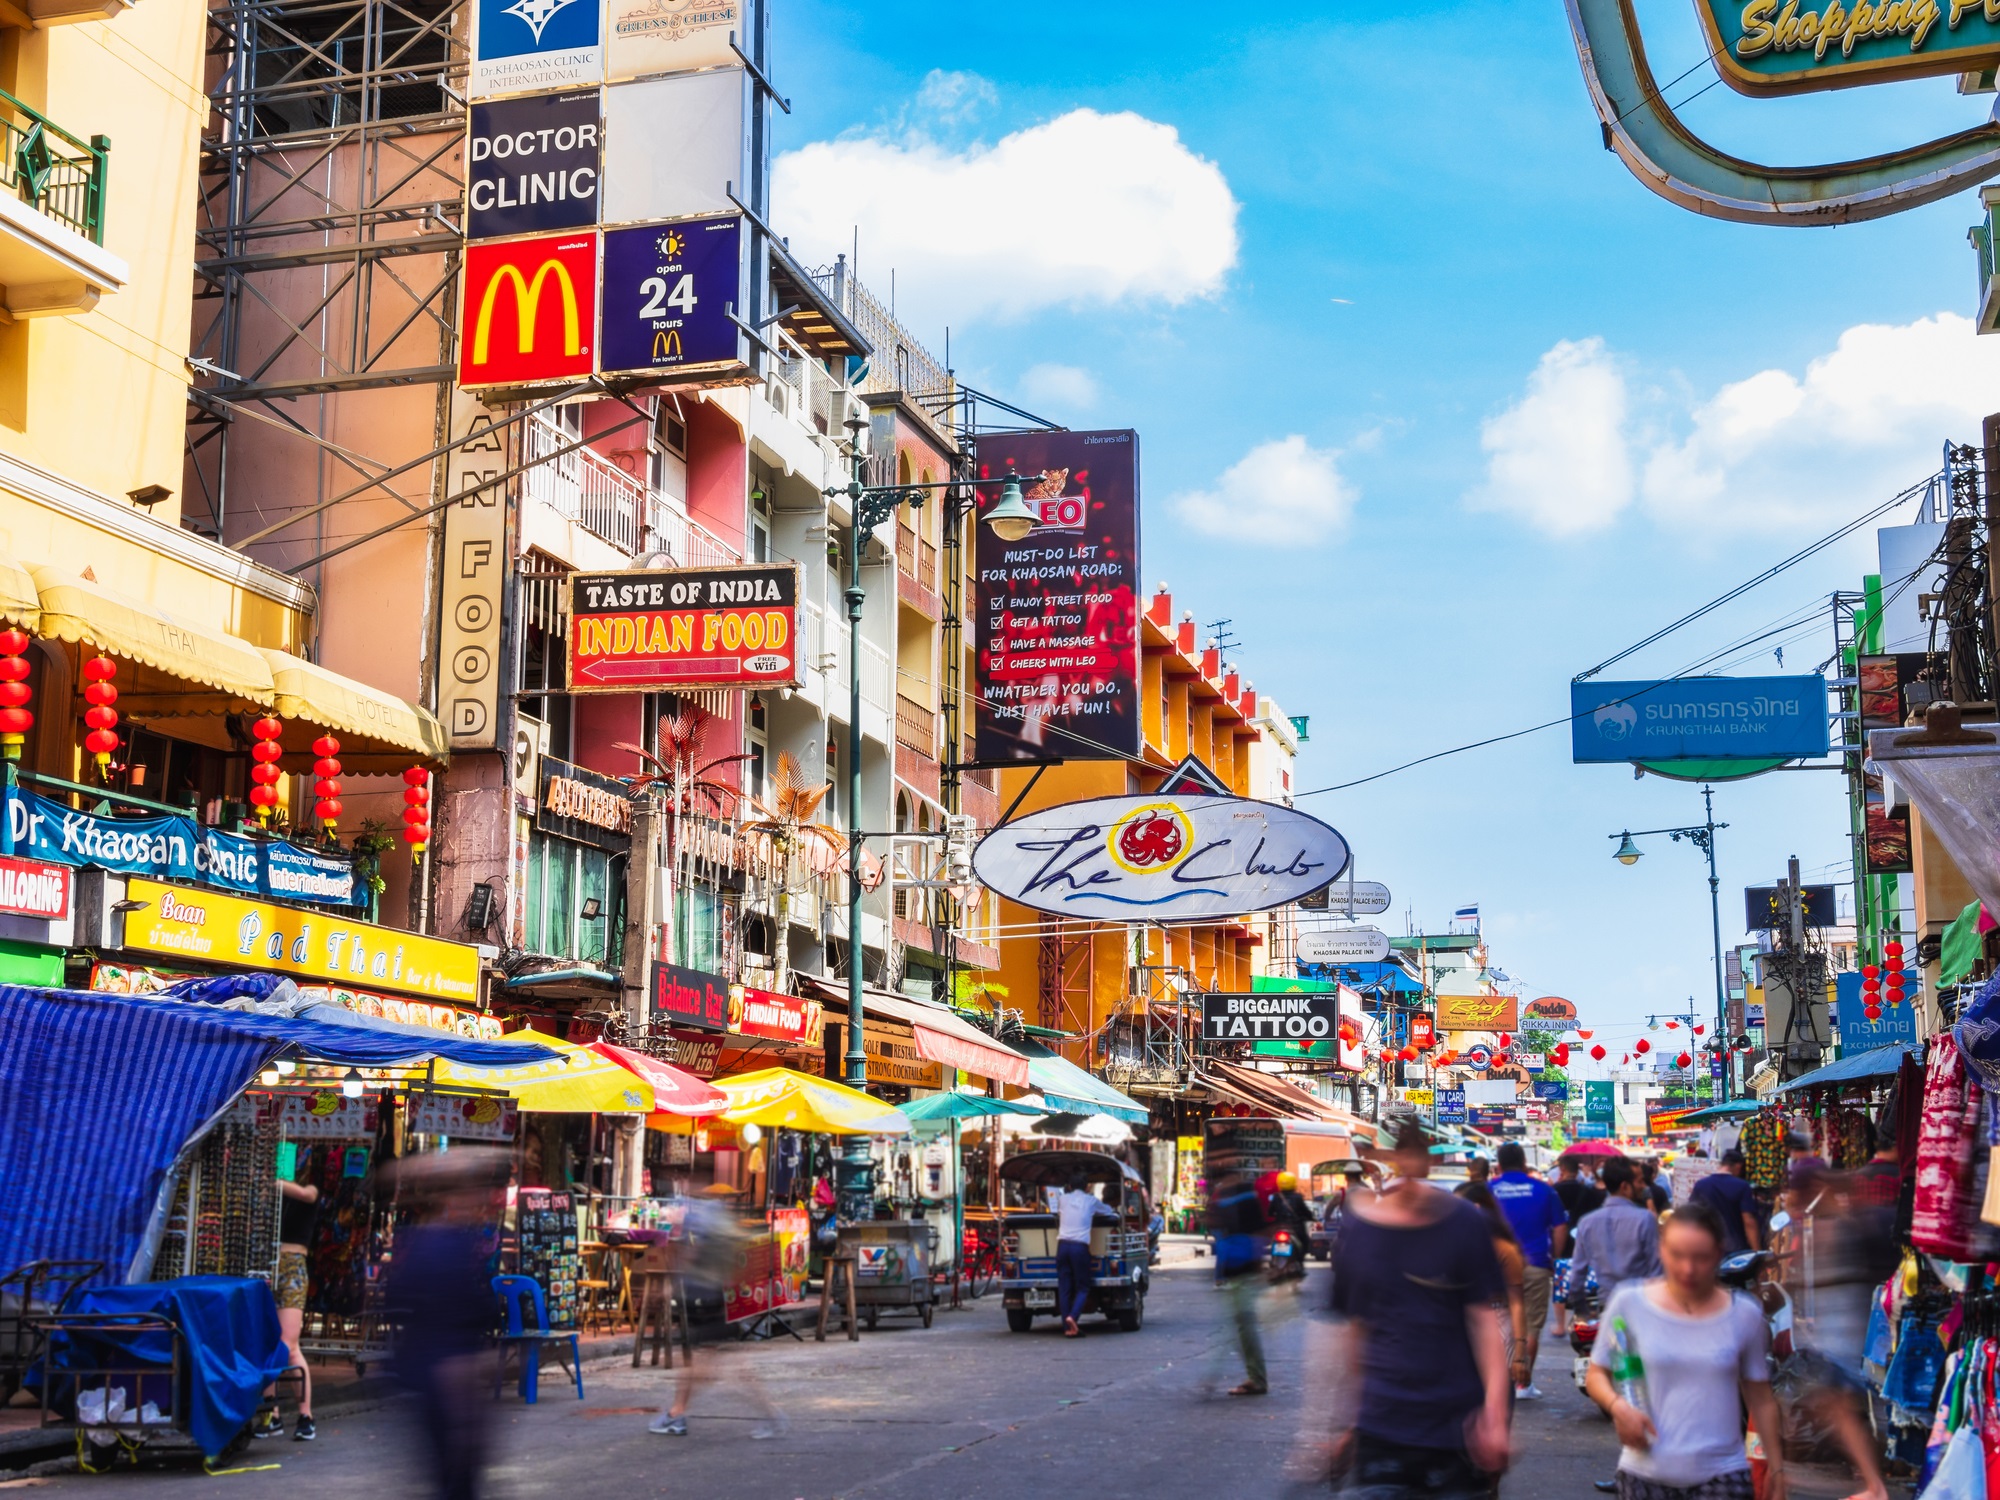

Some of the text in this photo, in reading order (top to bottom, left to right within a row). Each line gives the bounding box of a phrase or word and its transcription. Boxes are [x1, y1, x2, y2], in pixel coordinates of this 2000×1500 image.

[554, 53, 594, 67] CLINIC
[489, 68, 581, 89] INTERNATIONAL
[472, 124, 597, 162] DOCTOR
[470, 167, 595, 211] CLINIC
[656, 264, 682, 275] open
[640, 274, 697, 319] 24
[653, 320, 683, 329] hours
[1027, 499, 1084, 527] EO
[1005, 546, 1098, 563] MUST-DO LIST
[982, 569, 1008, 583] FOR
[1012, 565, 1076, 580] KHAOSAN
[587, 579, 781, 608] TASTE OF INDIA
[1010, 594, 1112, 608] ENJOY STREET FOOD
[1010, 615, 1082, 628] GET A TATTOO
[157, 622, 196, 656] THAI
[452, 540, 492, 736] FOOD
[578, 612, 788, 656] INDIAN FOOD
[1010, 635, 1095, 649] HAVE A MASSAGE
[754, 662, 777, 671] Wifi
[1010, 656, 1096, 669] CHEERS WITH LEO
[984, 681, 1121, 699] WHATEVER YOU DO,
[355, 696, 398, 729] HOTEL
[995, 701, 1110, 719] JUST HAVE FUN!
[1645, 697, 1799, 722] ธนาคารกรุงไทย
[1645, 722, 1768, 736] KRUNGTHAI BANK
[8, 798, 258, 882] Dr. Khaosan clinic
[1015, 824, 1325, 899] The Club
[268, 864, 353, 899] International
[160, 890, 206, 926] Baan
[239, 911, 404, 980] Pad Thai
[406, 967, 422, 985] Bar
[658, 972, 724, 1020] Balance Bar
[1227, 999, 1312, 1014] BIGGAINK
[1449, 998, 1508, 1017] Roof
[1533, 1003, 1567, 1016] Buddy
[749, 1002, 801, 1031] INDIAN FOOD
[1466, 1012, 1494, 1022] Bar
[1211, 1016, 1330, 1037] TATTOO
[1414, 1025, 1429, 1035] BAG
[863, 1039, 880, 1055] GOLF
[867, 1060, 892, 1078] STRONG
[893, 1063, 923, 1082] COCKTAILS
[1486, 1068, 1521, 1084] Buddy
[1407, 1092, 1416, 1100] VISA
[1447, 1092, 1465, 1103] CARD
[1588, 1102, 1612, 1112] Chang
